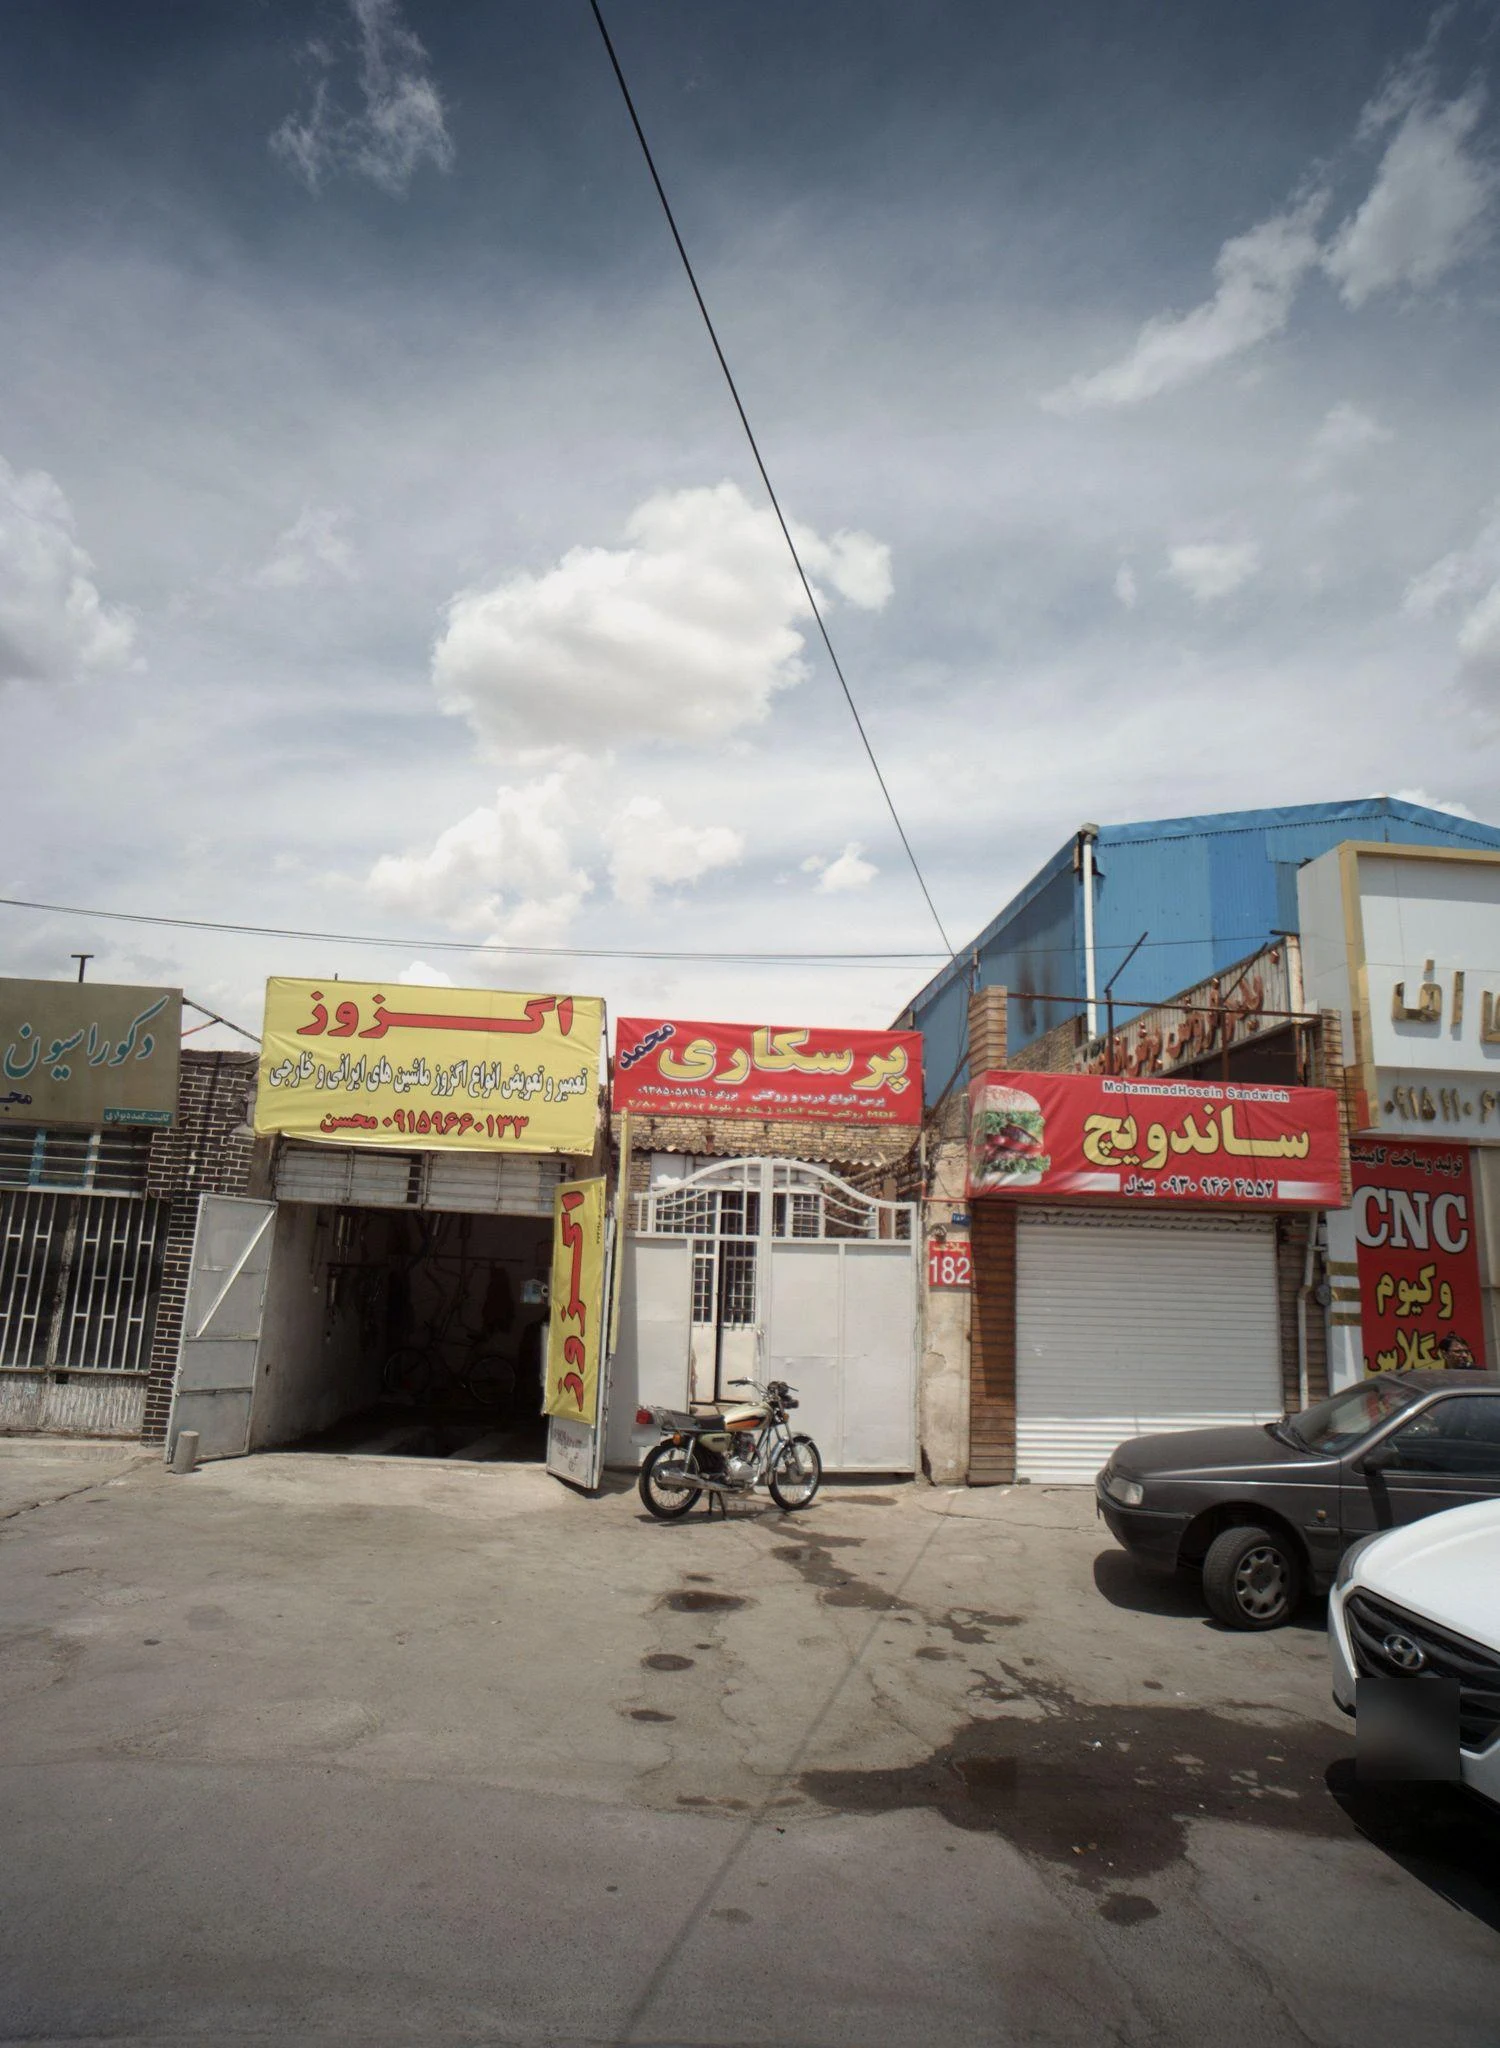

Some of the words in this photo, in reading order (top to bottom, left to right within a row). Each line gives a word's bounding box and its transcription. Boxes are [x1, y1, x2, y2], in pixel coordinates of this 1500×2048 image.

[297, 991, 573, 1038] اگزوز
[4, 995, 169, 1080] دکوراسیون
[619, 1023, 676, 1070] محمد
[269, 1051, 316, 1088] خارجی
[315, 1064, 326, 1089] و
[326, 1053, 366, 1092] ایرانی
[366, 1055, 393, 1092] های
[393, 1057, 431, 1094] ماشین
[431, 1059, 469, 1097] اگزوز
[468, 1060, 502, 1099] انواع
[501, 1064, 545, 1101] تعویض
[554, 1067, 589, 1102] تعمیر
[543, 1076, 554, 1102] و
[1103, 1080, 1223, 1099] MohammadHosein
[1227, 1086, 1290, 1102] Sandwich
[320, 1112, 379, 1134] محسن
[382, 1108, 530, 1139] ۰۹۱۵۹۶۶۰۱۳۳
[1083, 1103, 1310, 1170] ساندویچ
[1162, 1175, 1197, 1195] ۰۹۳۰
[1201, 1176, 1231, 1197] ۹۴۶
[1352, 1185, 1469, 1253] CNC
[930, 1255, 971, 1285] 182
[556, 1190, 586, 1412] اگزوز
